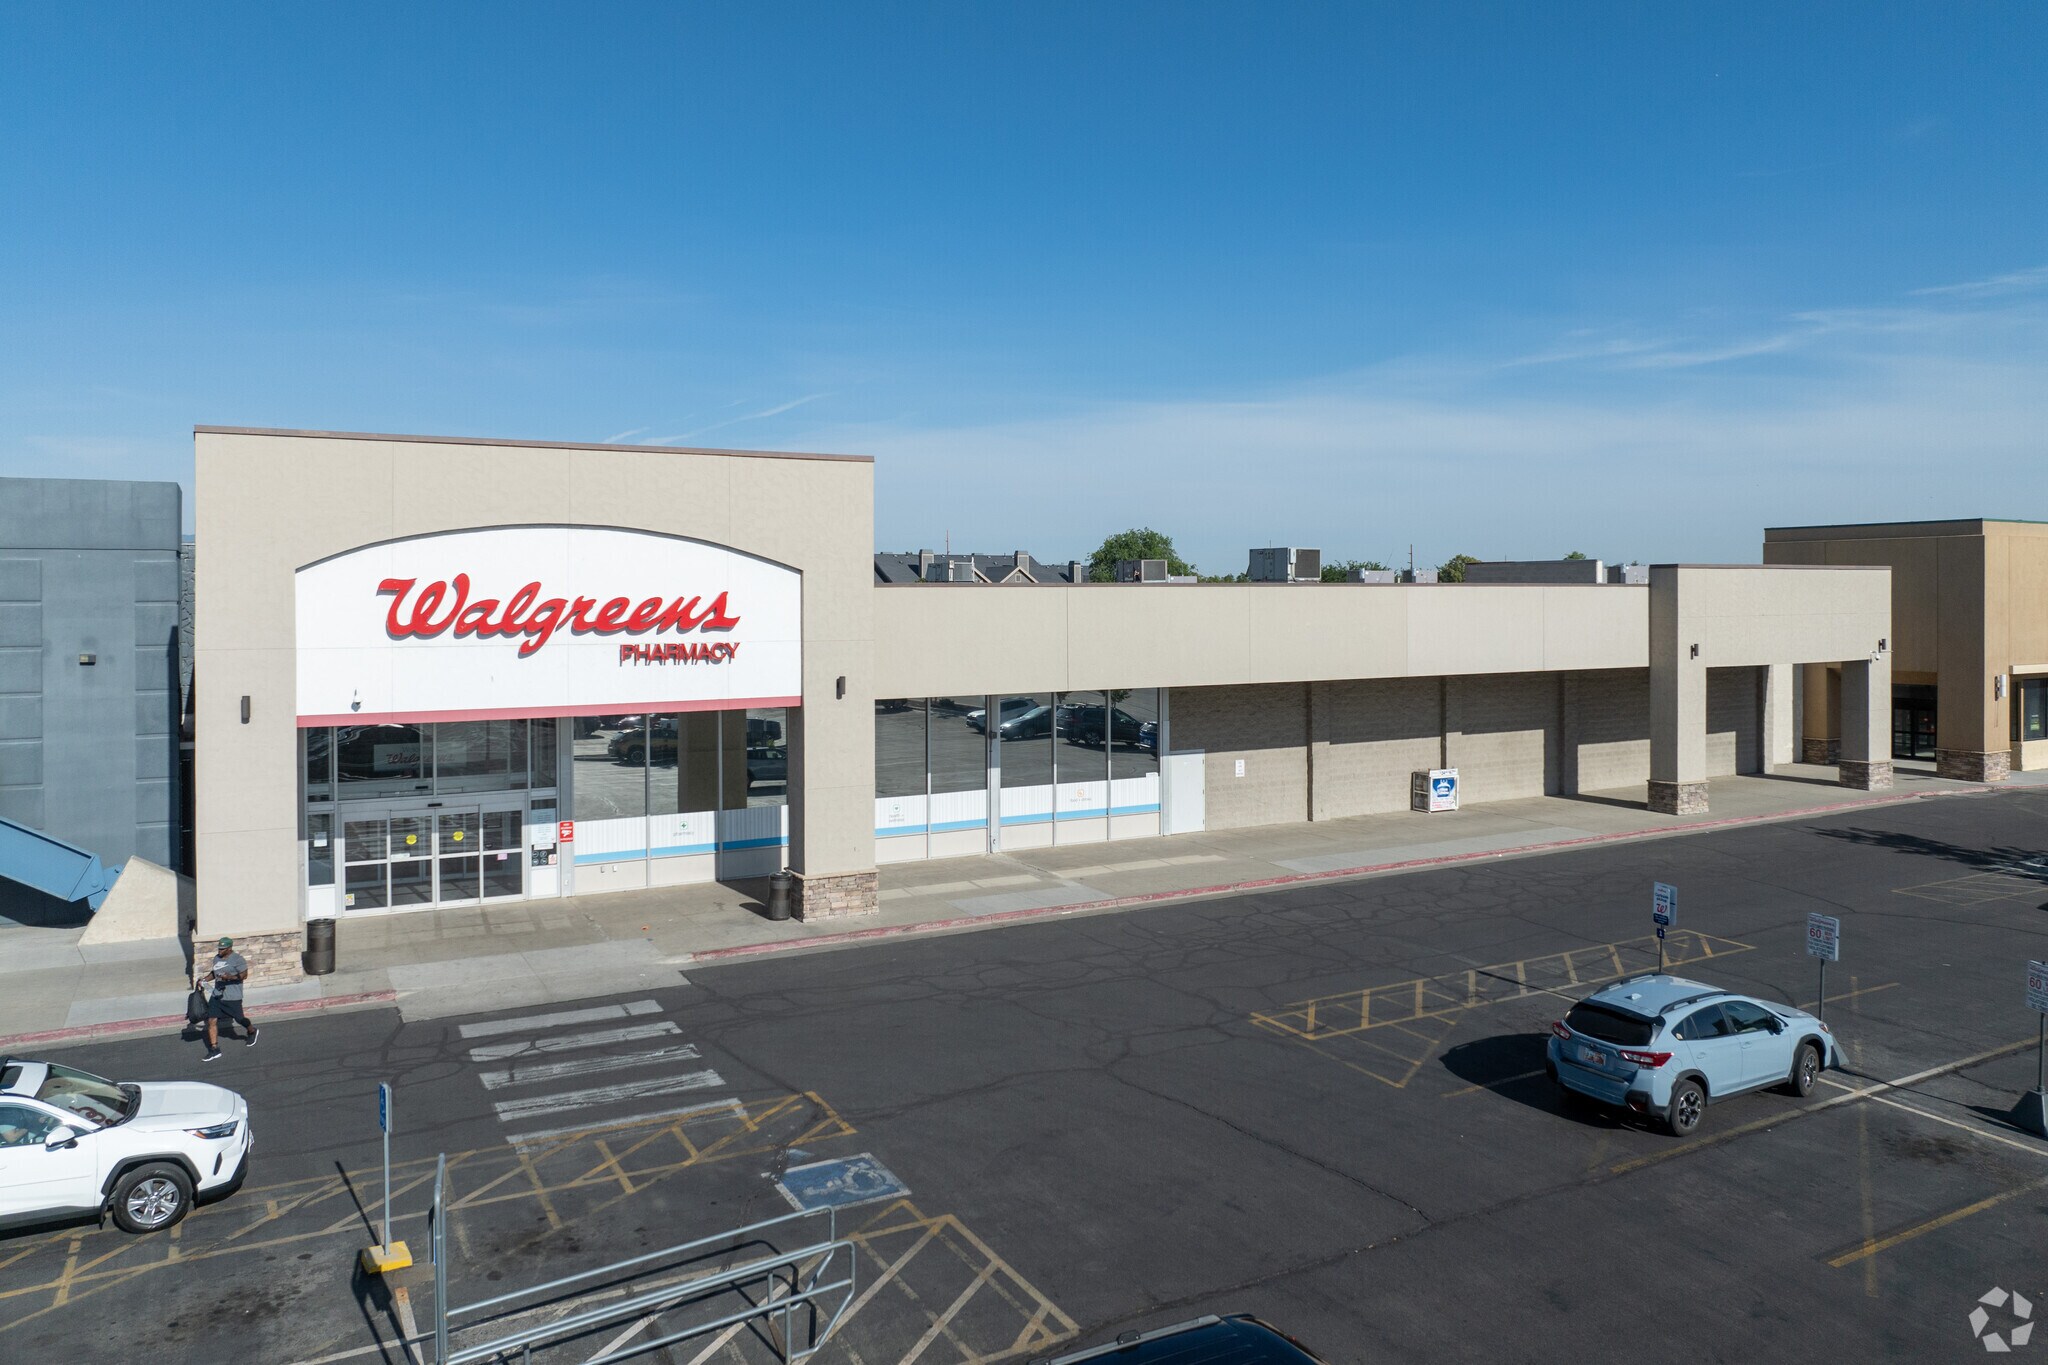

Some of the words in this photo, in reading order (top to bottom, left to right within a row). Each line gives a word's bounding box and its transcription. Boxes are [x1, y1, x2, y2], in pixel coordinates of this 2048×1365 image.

[377, 572, 741, 656] Walgreens
[620, 642, 740, 664] PHARMACY
[1809, 927, 1822, 938] 60
[2029, 977, 2041, 989] 60
